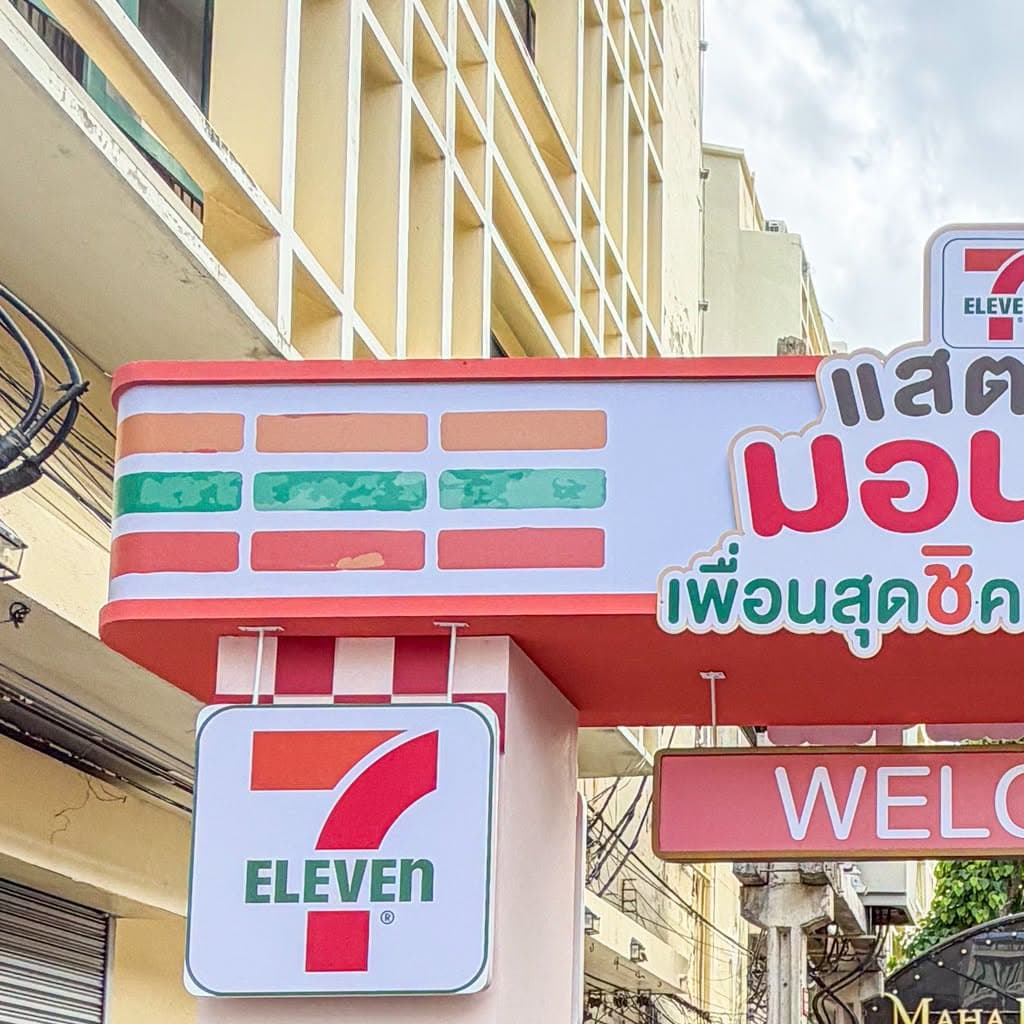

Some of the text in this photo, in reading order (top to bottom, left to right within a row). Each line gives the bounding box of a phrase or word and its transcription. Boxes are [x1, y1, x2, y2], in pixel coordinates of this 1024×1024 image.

[667, 541, 1020, 649] เพื่อนสุดชิค
[249, 729, 439, 973] 7
